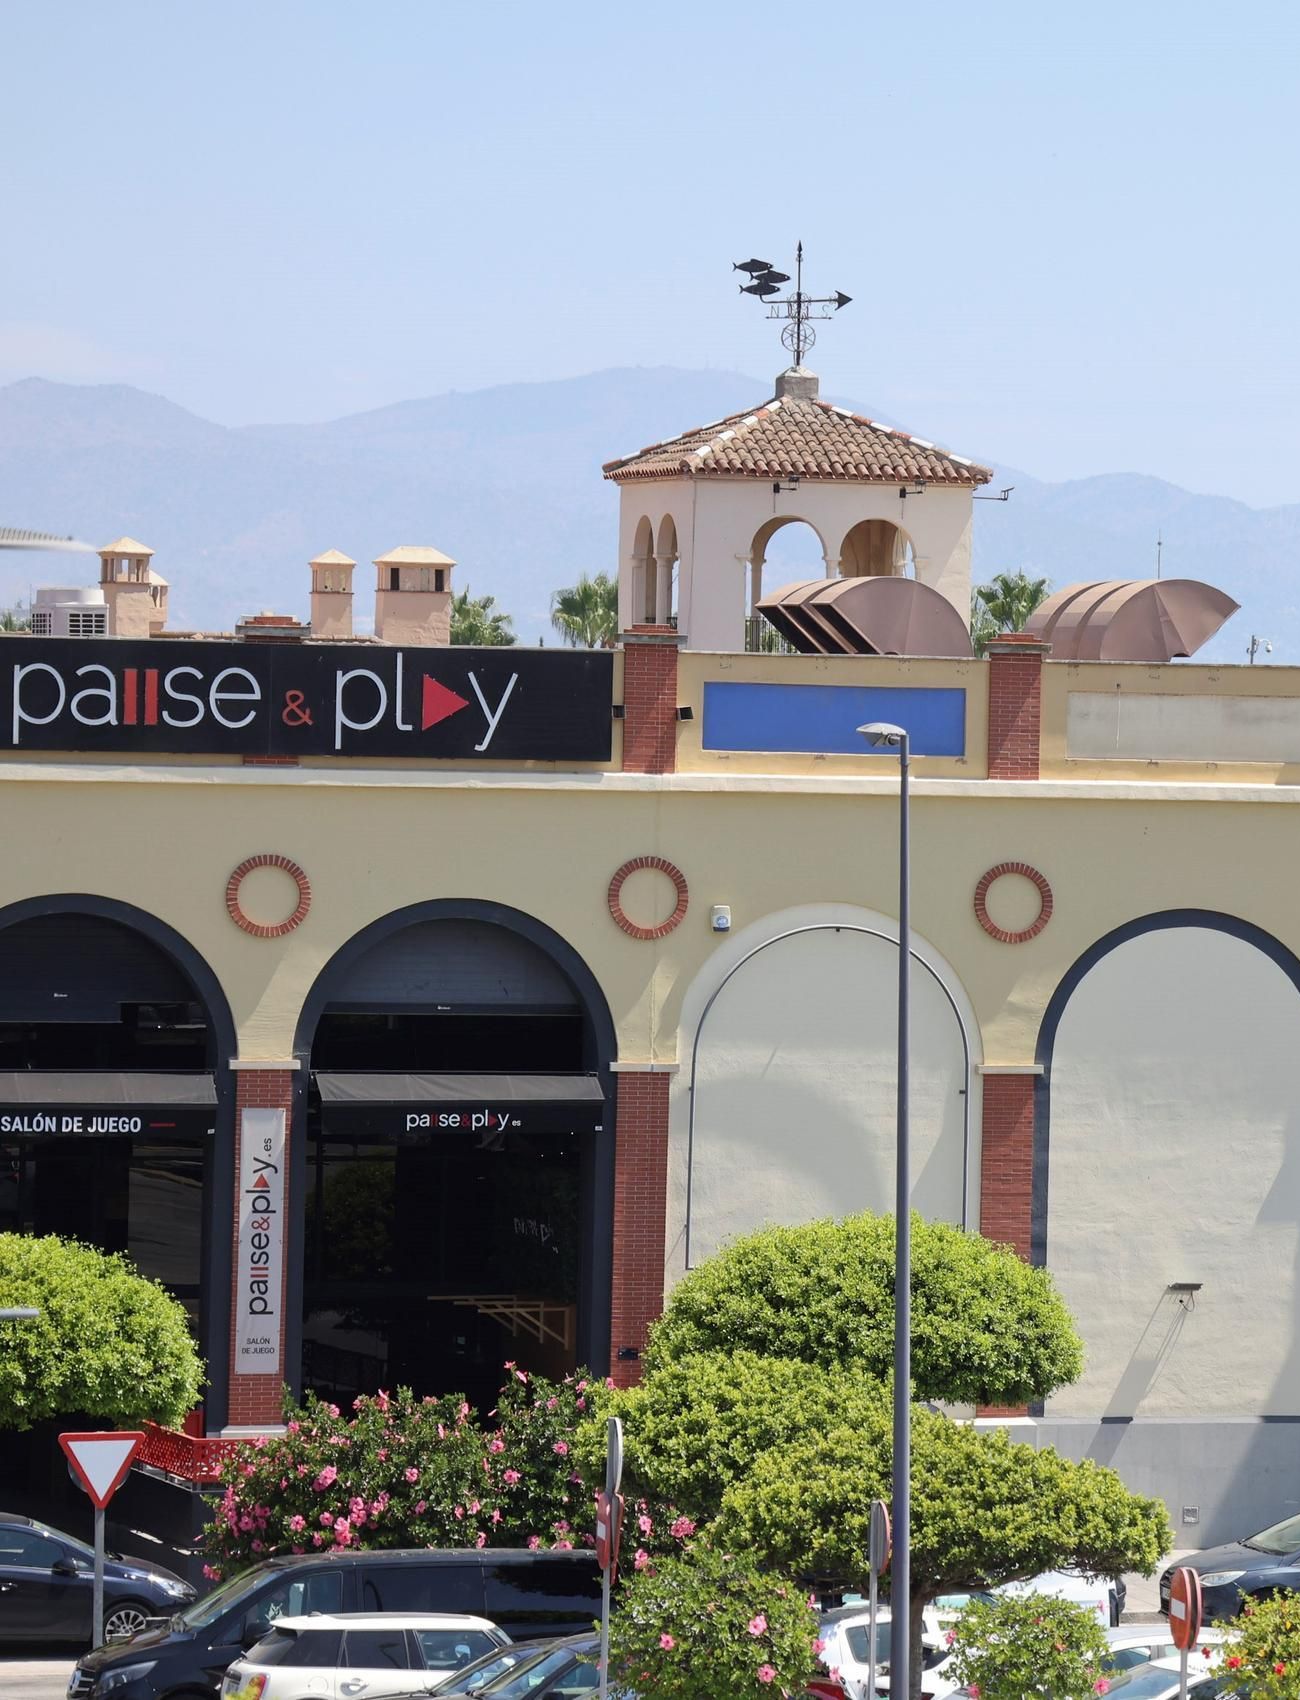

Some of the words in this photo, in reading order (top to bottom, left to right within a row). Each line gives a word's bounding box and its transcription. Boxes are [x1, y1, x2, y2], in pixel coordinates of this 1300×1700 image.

[282, 689, 313, 726] &
[1, 1113, 56, 1132] SALÓN
[61, 1117, 83, 1132] DE
[87, 1117, 141, 1132] JUEGO
[246, 1336, 270, 1345] SALÓN
